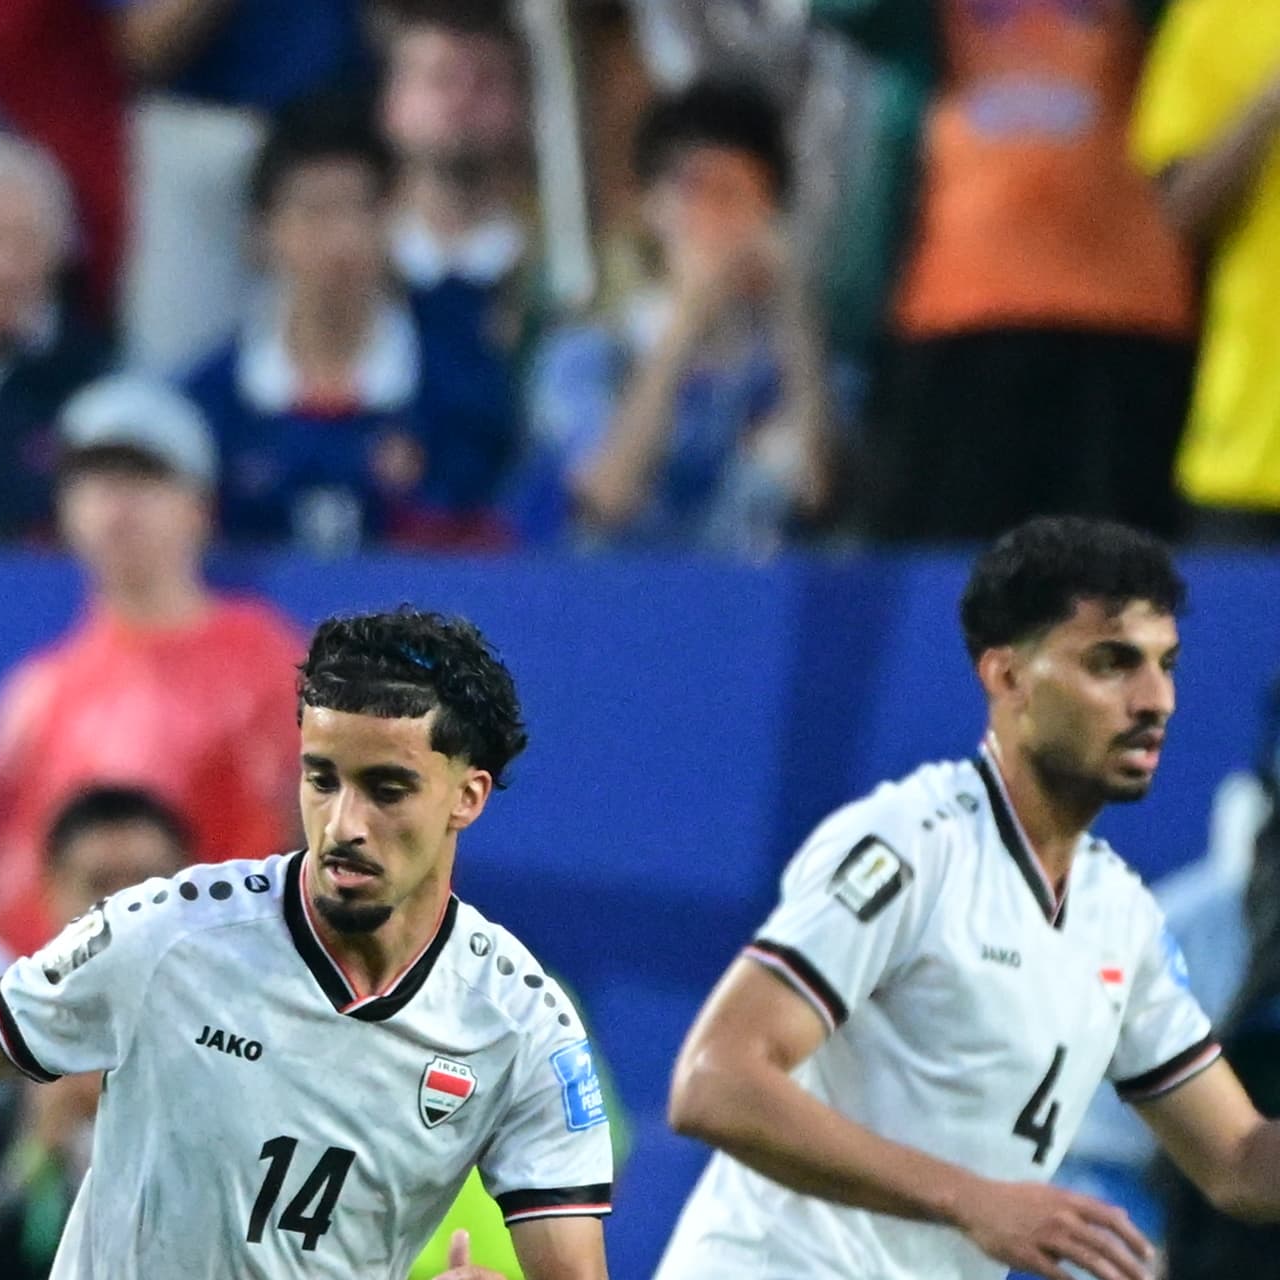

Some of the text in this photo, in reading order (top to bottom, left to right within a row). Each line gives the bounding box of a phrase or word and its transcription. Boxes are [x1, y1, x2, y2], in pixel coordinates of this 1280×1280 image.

[195, 1025, 263, 1061] JAKO
[438, 1061, 468, 1077] IRAQ
[1012, 1043, 1067, 1166] 4
[246, 1135, 357, 1251] 14
